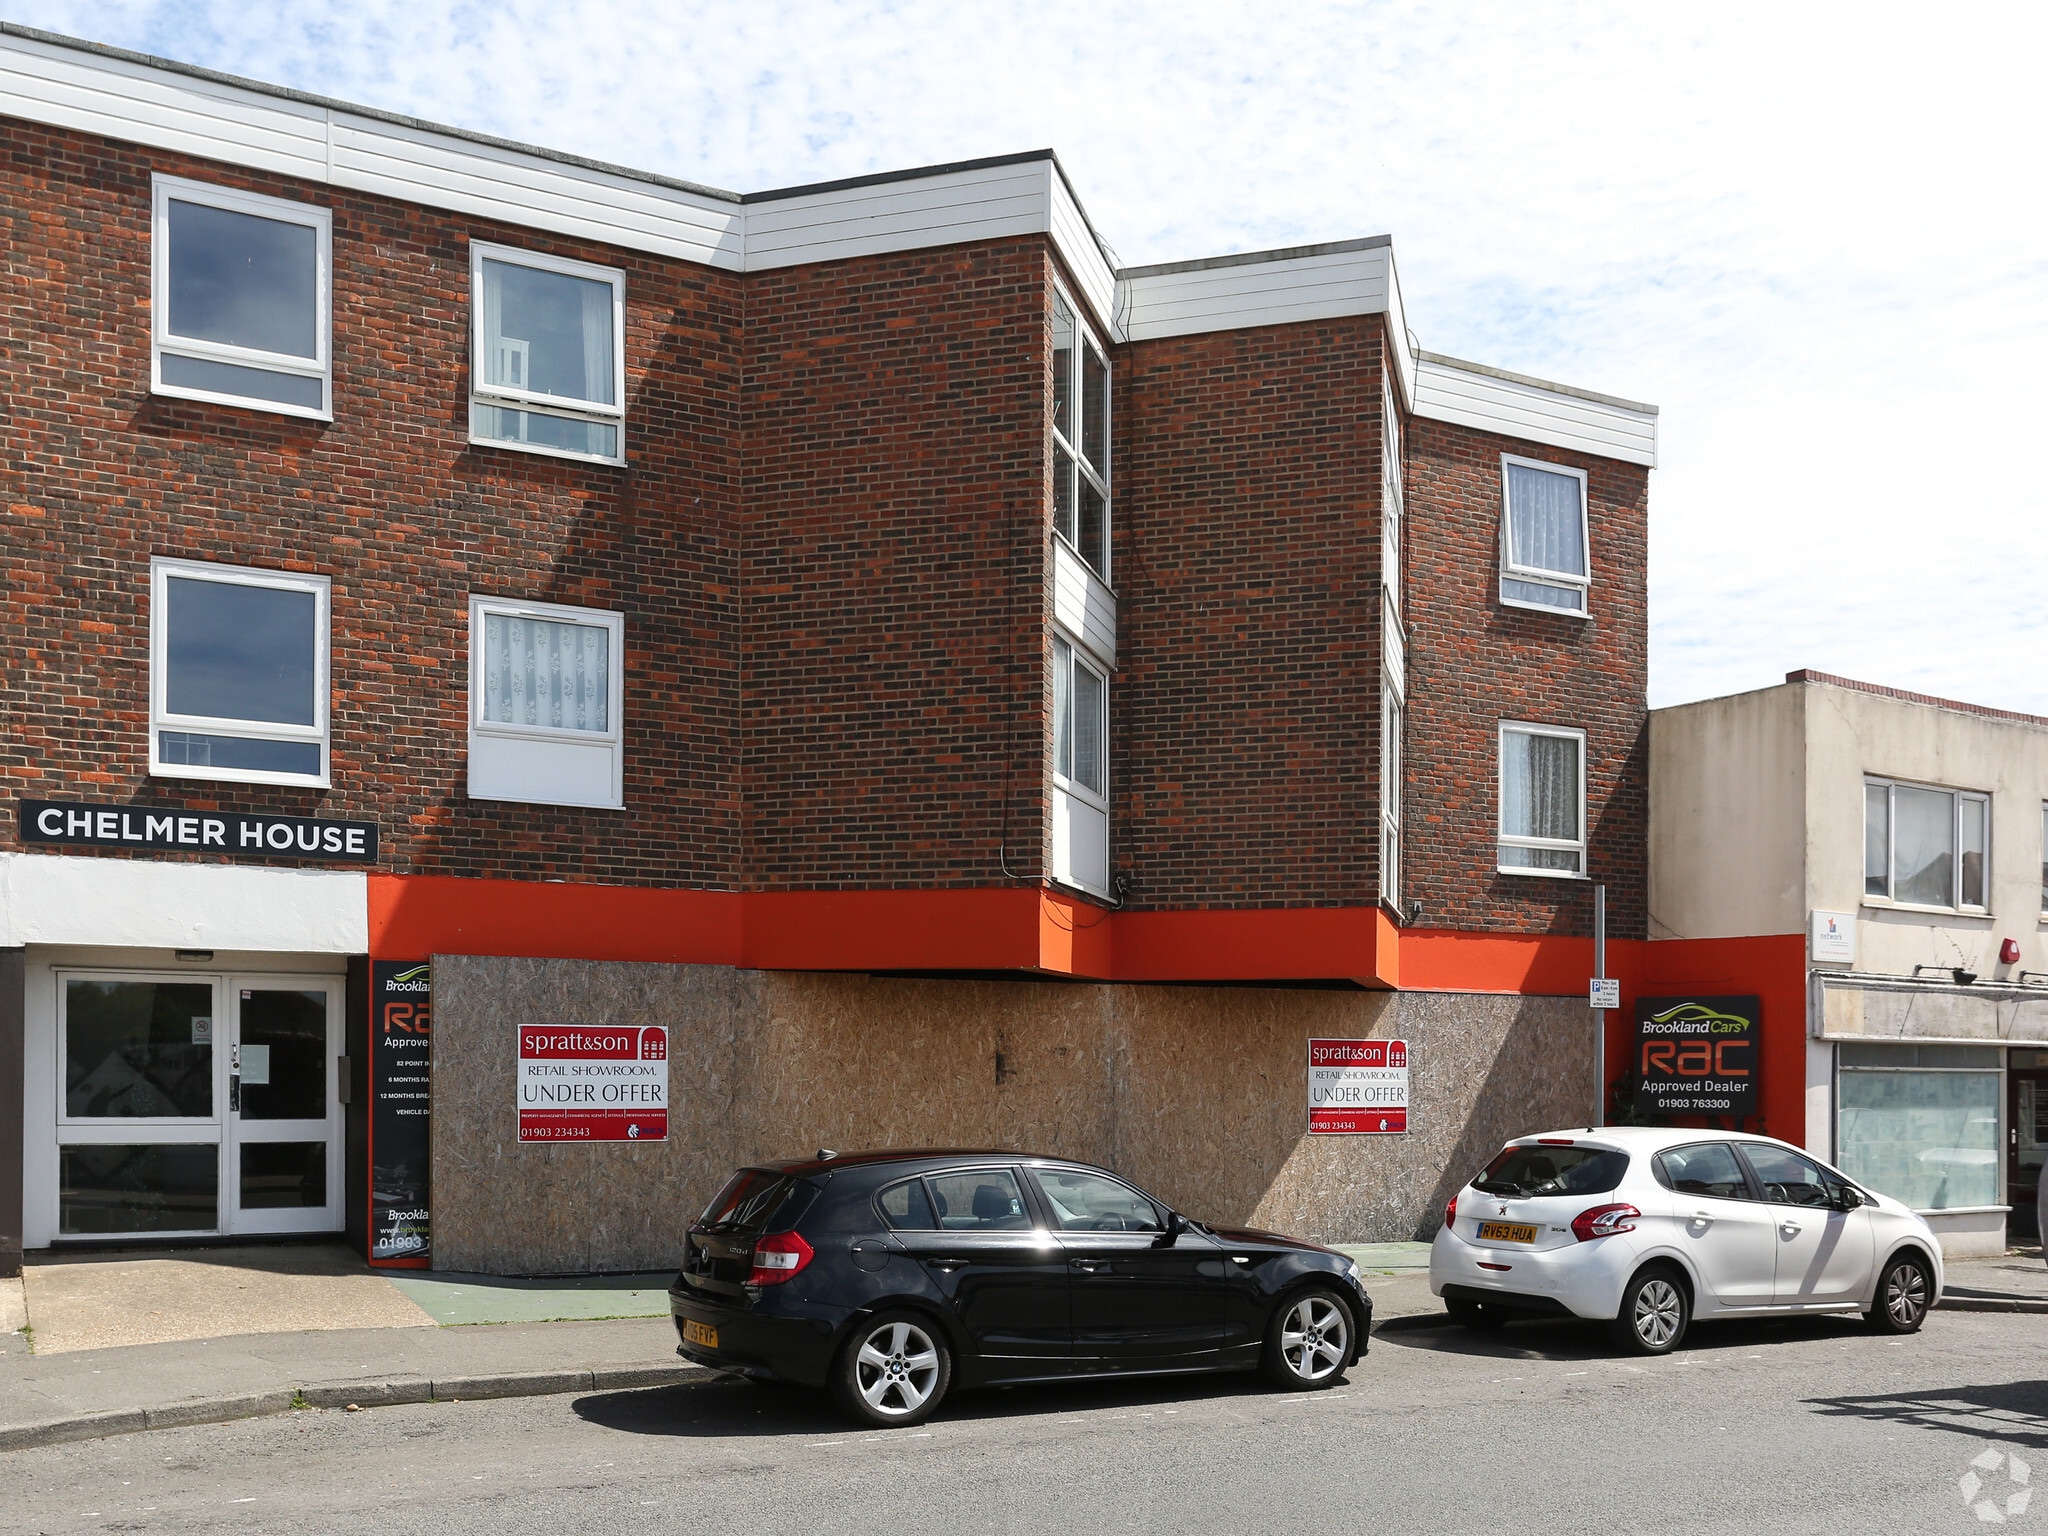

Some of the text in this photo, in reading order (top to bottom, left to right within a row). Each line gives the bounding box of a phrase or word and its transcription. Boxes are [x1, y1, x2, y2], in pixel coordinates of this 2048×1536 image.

[37, 808, 366, 855] CHELMER HOUSE
[385, 979, 430, 991] Brookla
[525, 1033, 629, 1055] spratt&son
[1313, 1045, 1381, 1064] spratt&son
[1642, 1040, 1750, 1076] RAC
[528, 1065, 568, 1076] RETAIL
[1315, 1070, 1341, 1080] RETAIL
[523, 1084, 662, 1102] UNDER OFFER
[1641, 1080, 1749, 1094] Approved Dealer
[1312, 1087, 1405, 1102] UNDER OFFER
[1658, 1098, 1730, 1109] 01903 763300
[521, 1127, 591, 1137] 01903 234343
[1310, 1121, 1356, 1130] 01903 234343
[388, 1209, 429, 1220] Brookla
[379, 1226, 430, 1234] www.brookla
[1482, 1224, 1533, 1241] RV63 HUA
[379, 1236, 422, 1249] 01903
